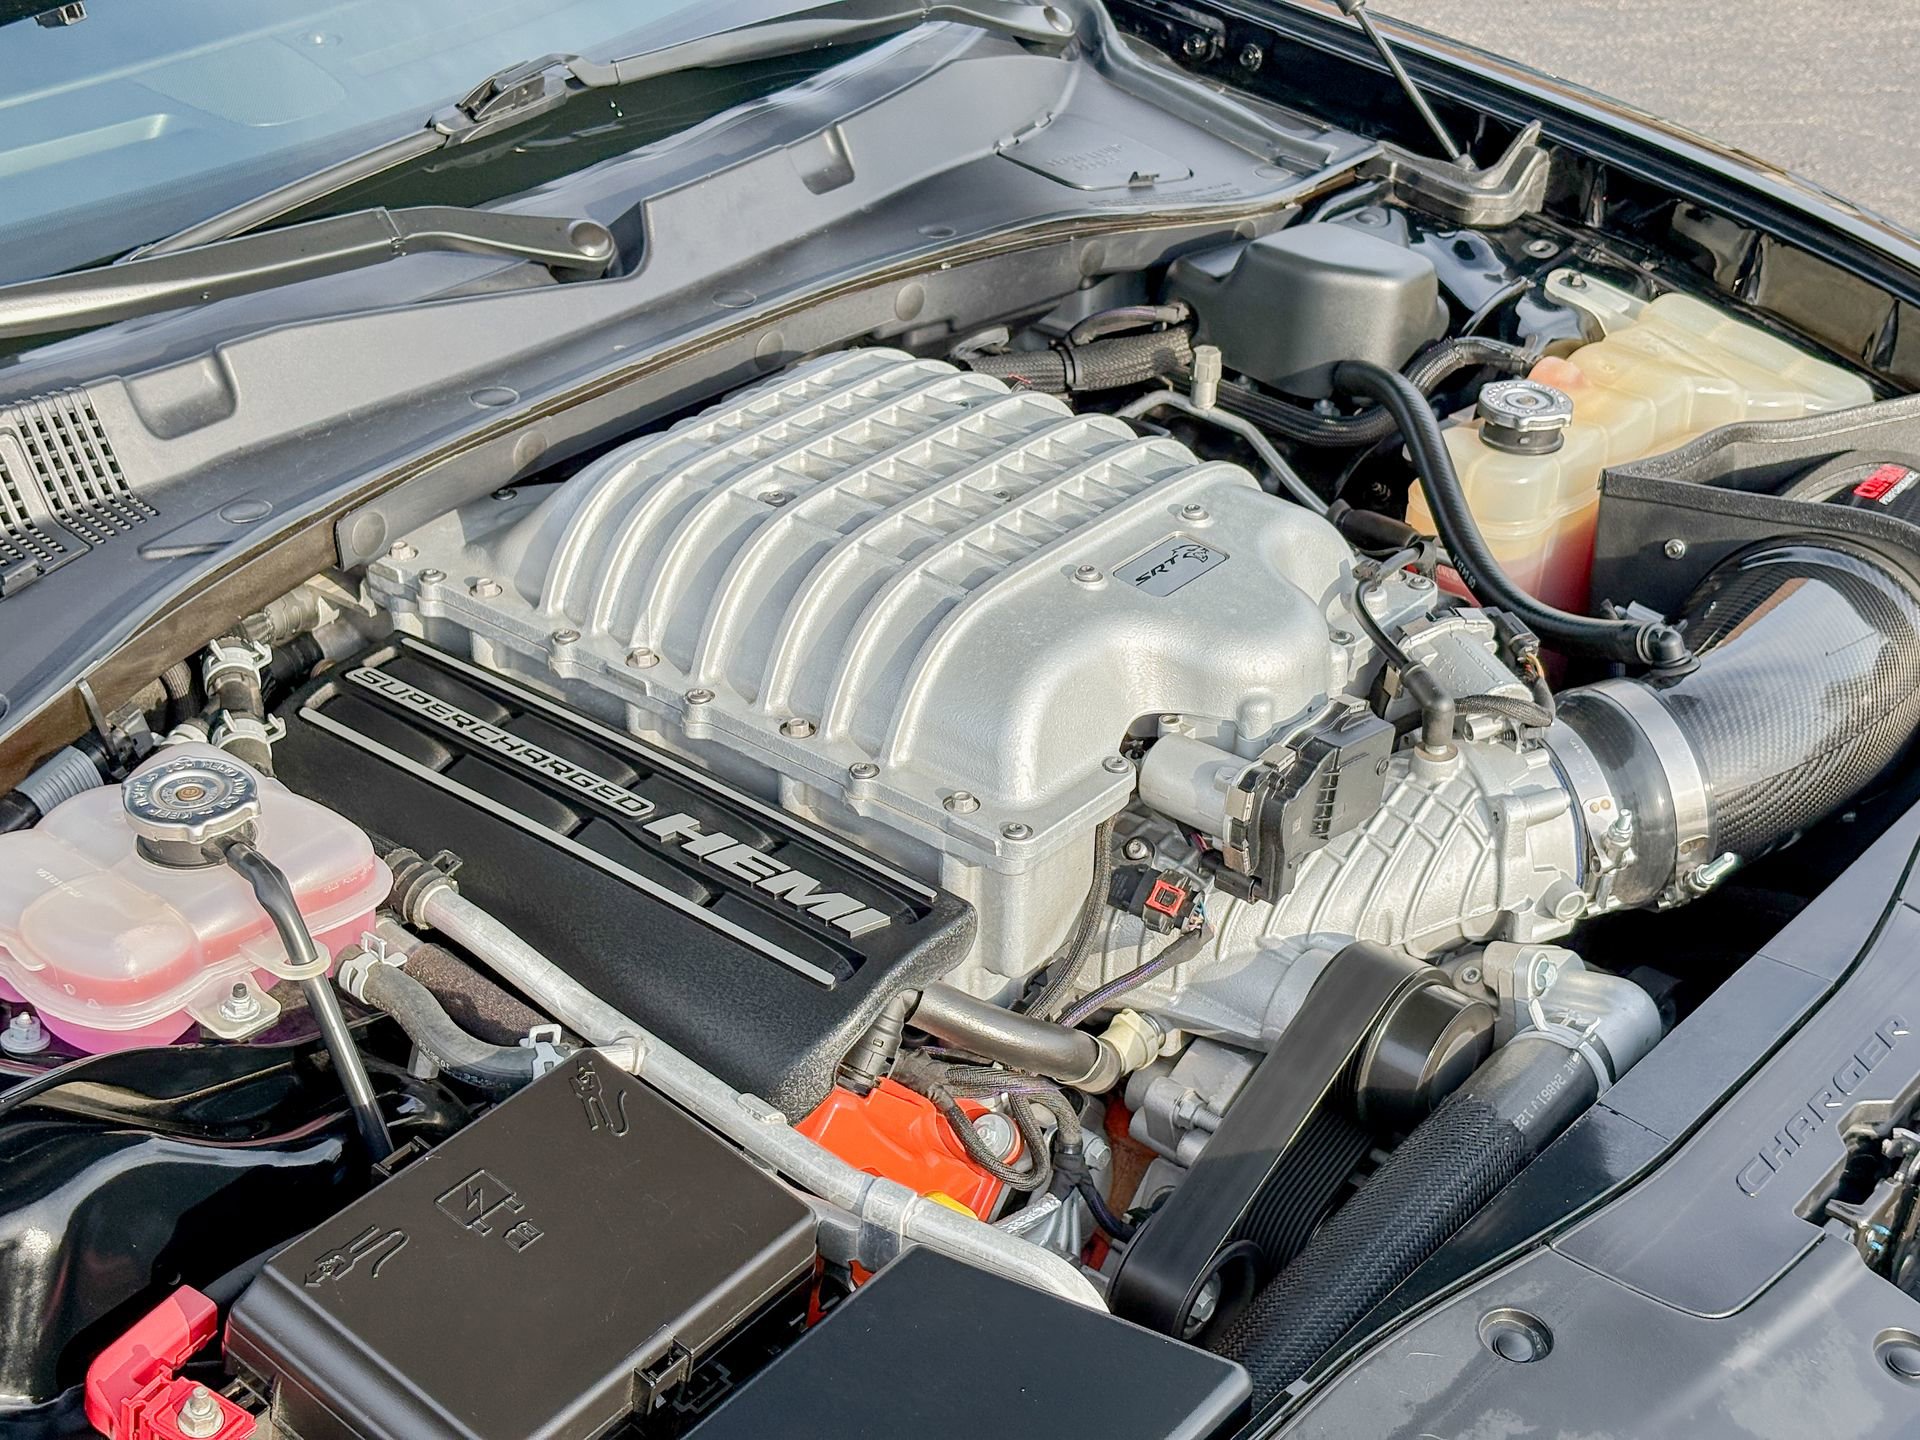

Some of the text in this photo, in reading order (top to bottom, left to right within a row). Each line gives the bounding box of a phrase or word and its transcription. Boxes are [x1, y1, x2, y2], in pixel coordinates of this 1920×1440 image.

[1136, 554, 1179, 587] SRT
[359, 669, 892, 939] SUPERCHARGED HEMI
[1735, 1014, 1910, 1198] CHARGER
